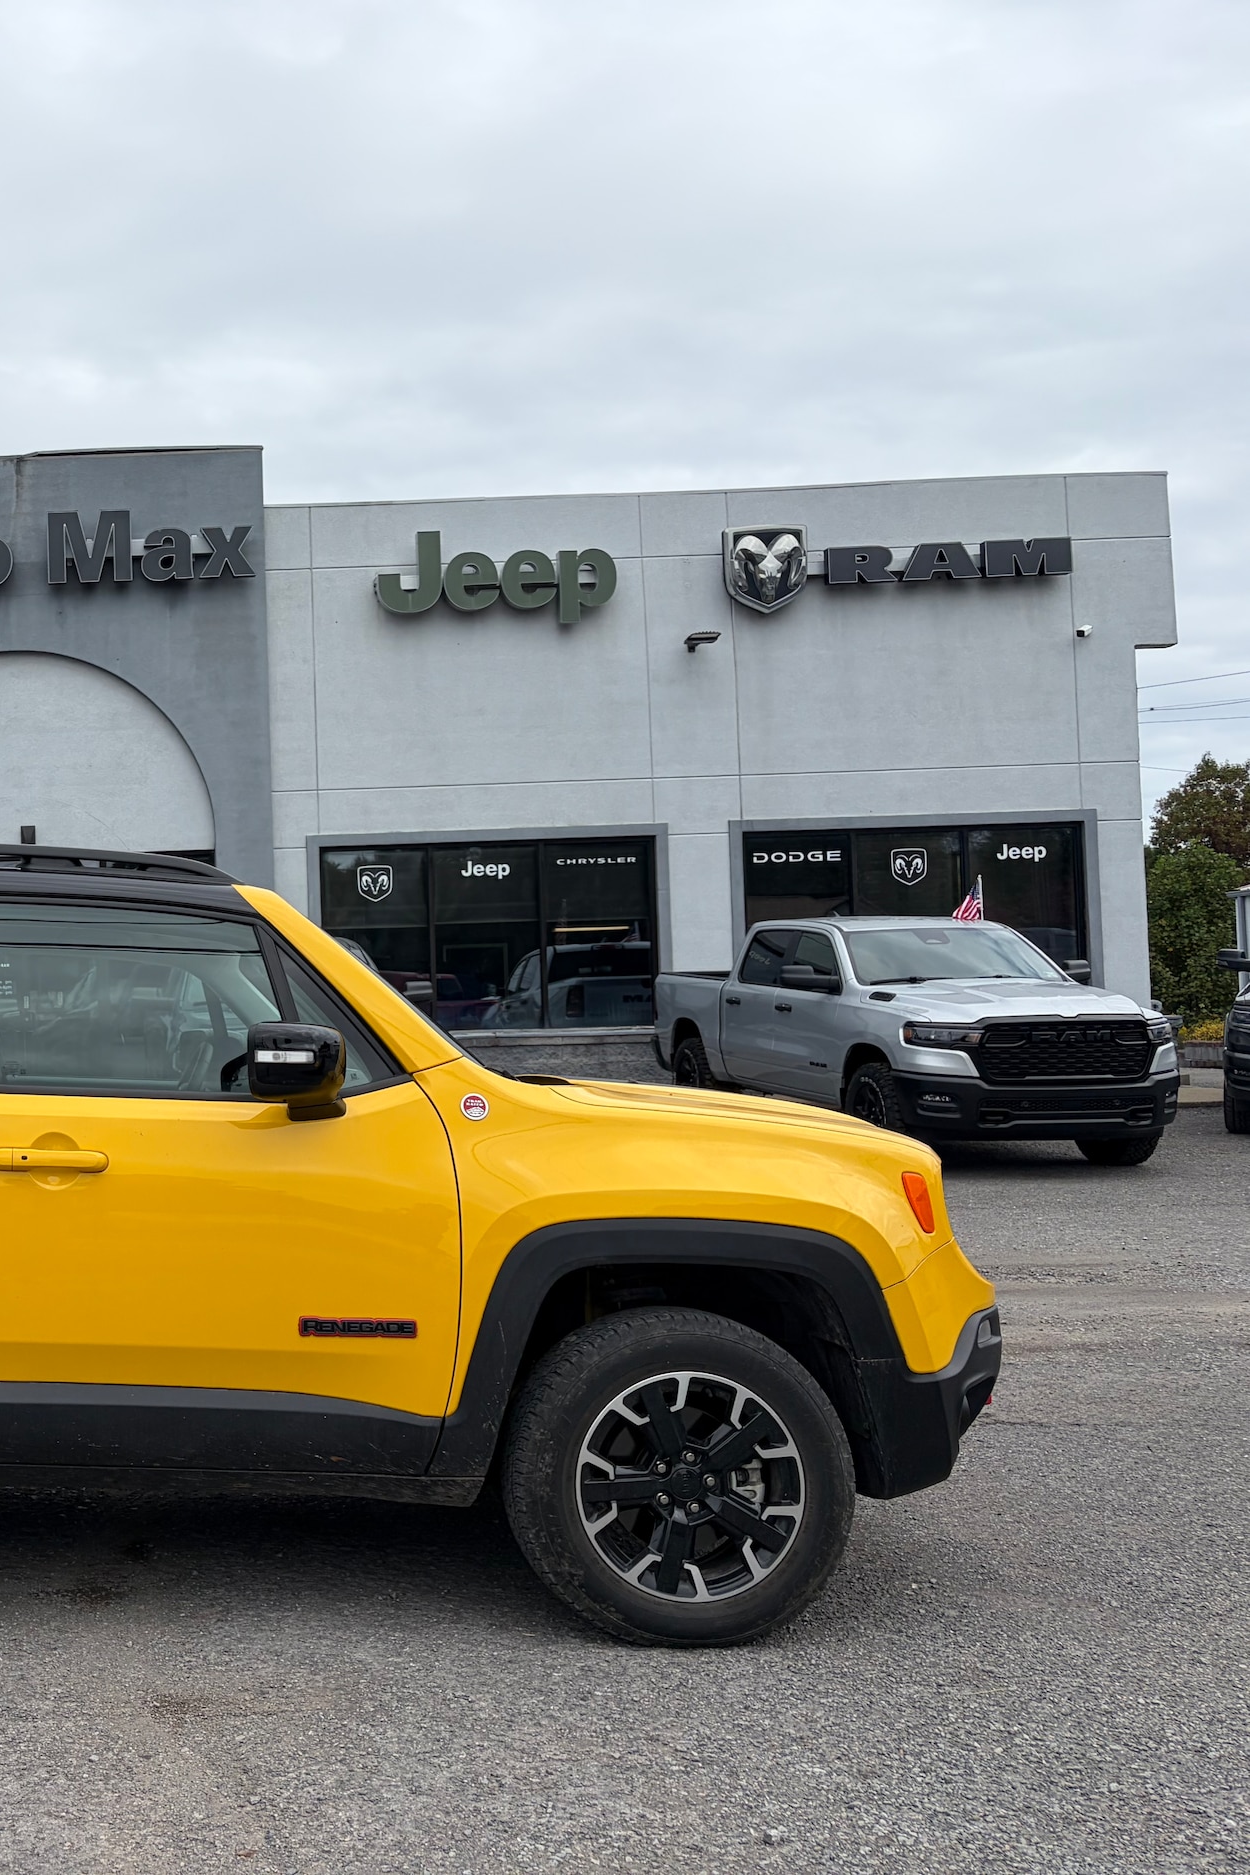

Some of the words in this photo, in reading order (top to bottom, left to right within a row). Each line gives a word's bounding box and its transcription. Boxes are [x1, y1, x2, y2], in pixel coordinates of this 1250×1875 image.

[47, 509, 256, 584] Max
[824, 536, 1073, 585] RAM
[374, 530, 617, 624] Jeep
[556, 856, 637, 866] CHRYSLER
[752, 850, 842, 863] DODGE
[996, 843, 1047, 863] Jeep
[461, 860, 511, 880] Jeep
[1031, 1030, 1111, 1043] RAM
[302, 1319, 415, 1334] RENEGADE
